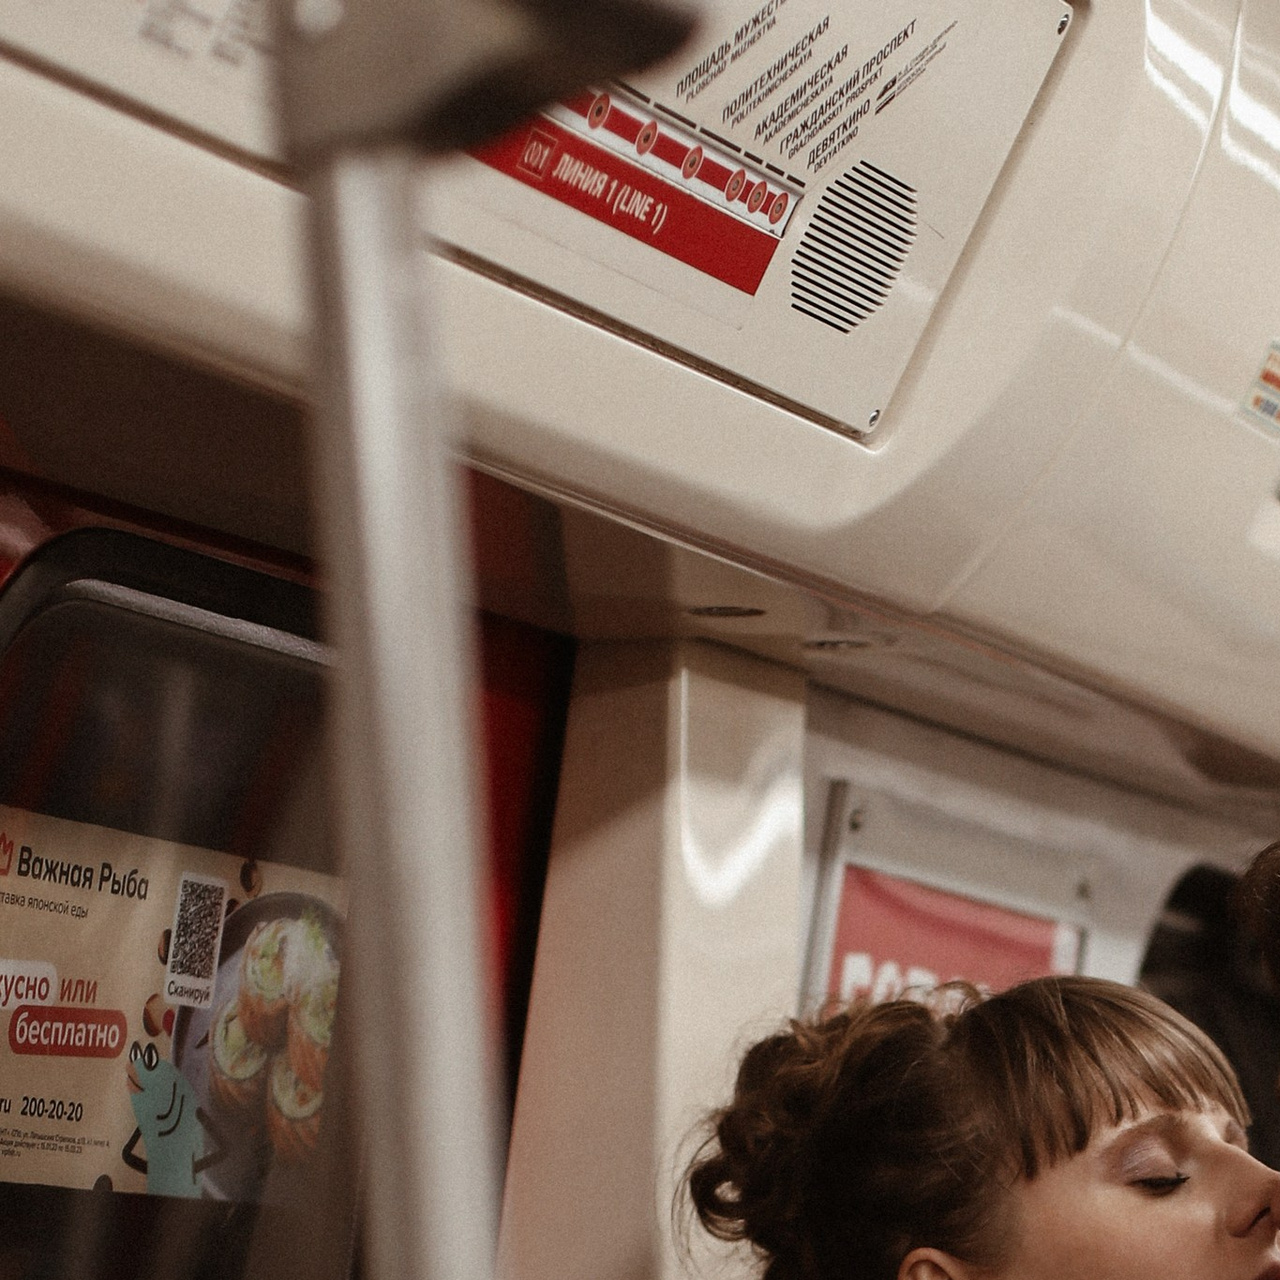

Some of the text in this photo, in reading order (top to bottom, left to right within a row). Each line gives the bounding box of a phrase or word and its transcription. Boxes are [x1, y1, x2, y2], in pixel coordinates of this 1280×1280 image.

[676, 40, 731, 98] ПЛОЩАДЬ
[722, 15, 830, 123] ПОЛИТЕХНИЧЕСКАЯ
[731, 15, 776, 63] MUZHESTVA
[731, 48, 813, 129] POLITEKHNICHESKAYA
[754, 44, 849, 141] АКАДЕМИЧЕСКАЯ
[763, 75, 833, 146] AKADEMICHESKAYA
[779, 67, 861, 155] ГРАЖДАНСКИЙ
[862, 18, 917, 79] ПРОСПЕКТ
[788, 66, 884, 159] GRAZHDANSKIY PROSPEKT
[807, 99, 871, 169] ДЕВЯТКИНО
[814, 126, 859, 173] DEVYATKINO
[552, 152, 668, 235] ЛИНИЯ 1 (LINE 1)
[17, 846, 149, 900] Важная Рыба
[27, 896, 69, 916] японской
[70, 906, 89, 920] еды
[60, 977, 98, 1004] или
[167, 980, 211, 1005] Сканируй
[15, 1011, 120, 1049] бесплатно
